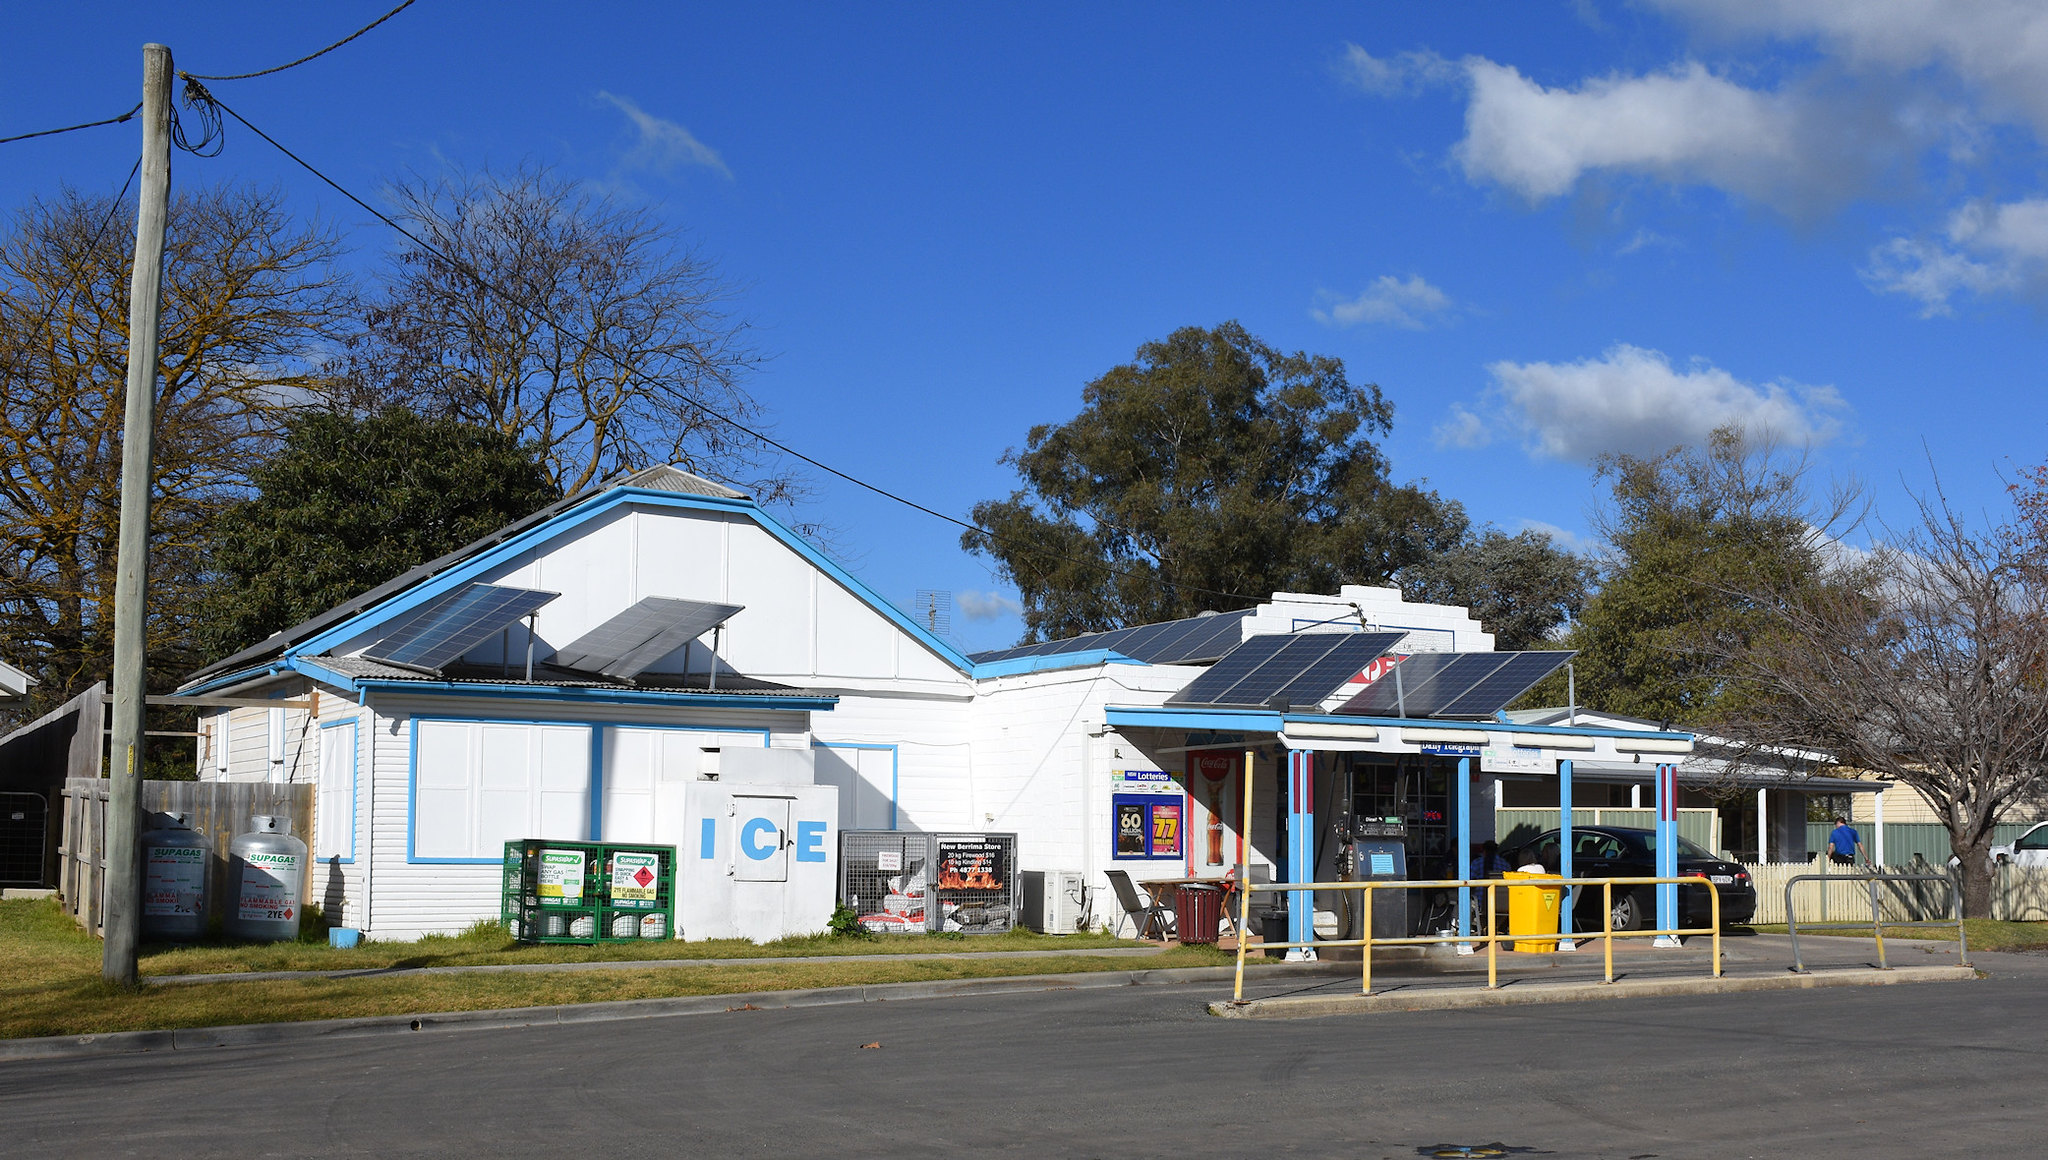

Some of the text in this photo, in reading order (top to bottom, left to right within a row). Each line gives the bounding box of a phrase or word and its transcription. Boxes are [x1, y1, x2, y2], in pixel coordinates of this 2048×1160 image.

[1137, 772, 1169, 781] Lotteries
[700, 817, 828, 863] ICE
[154, 848, 202, 857] SUPAGAS
[250, 853, 296, 863] SUPAGAS
[239, 897, 282, 905] FLAMMABLE
[267, 910, 283, 919] 2YE
